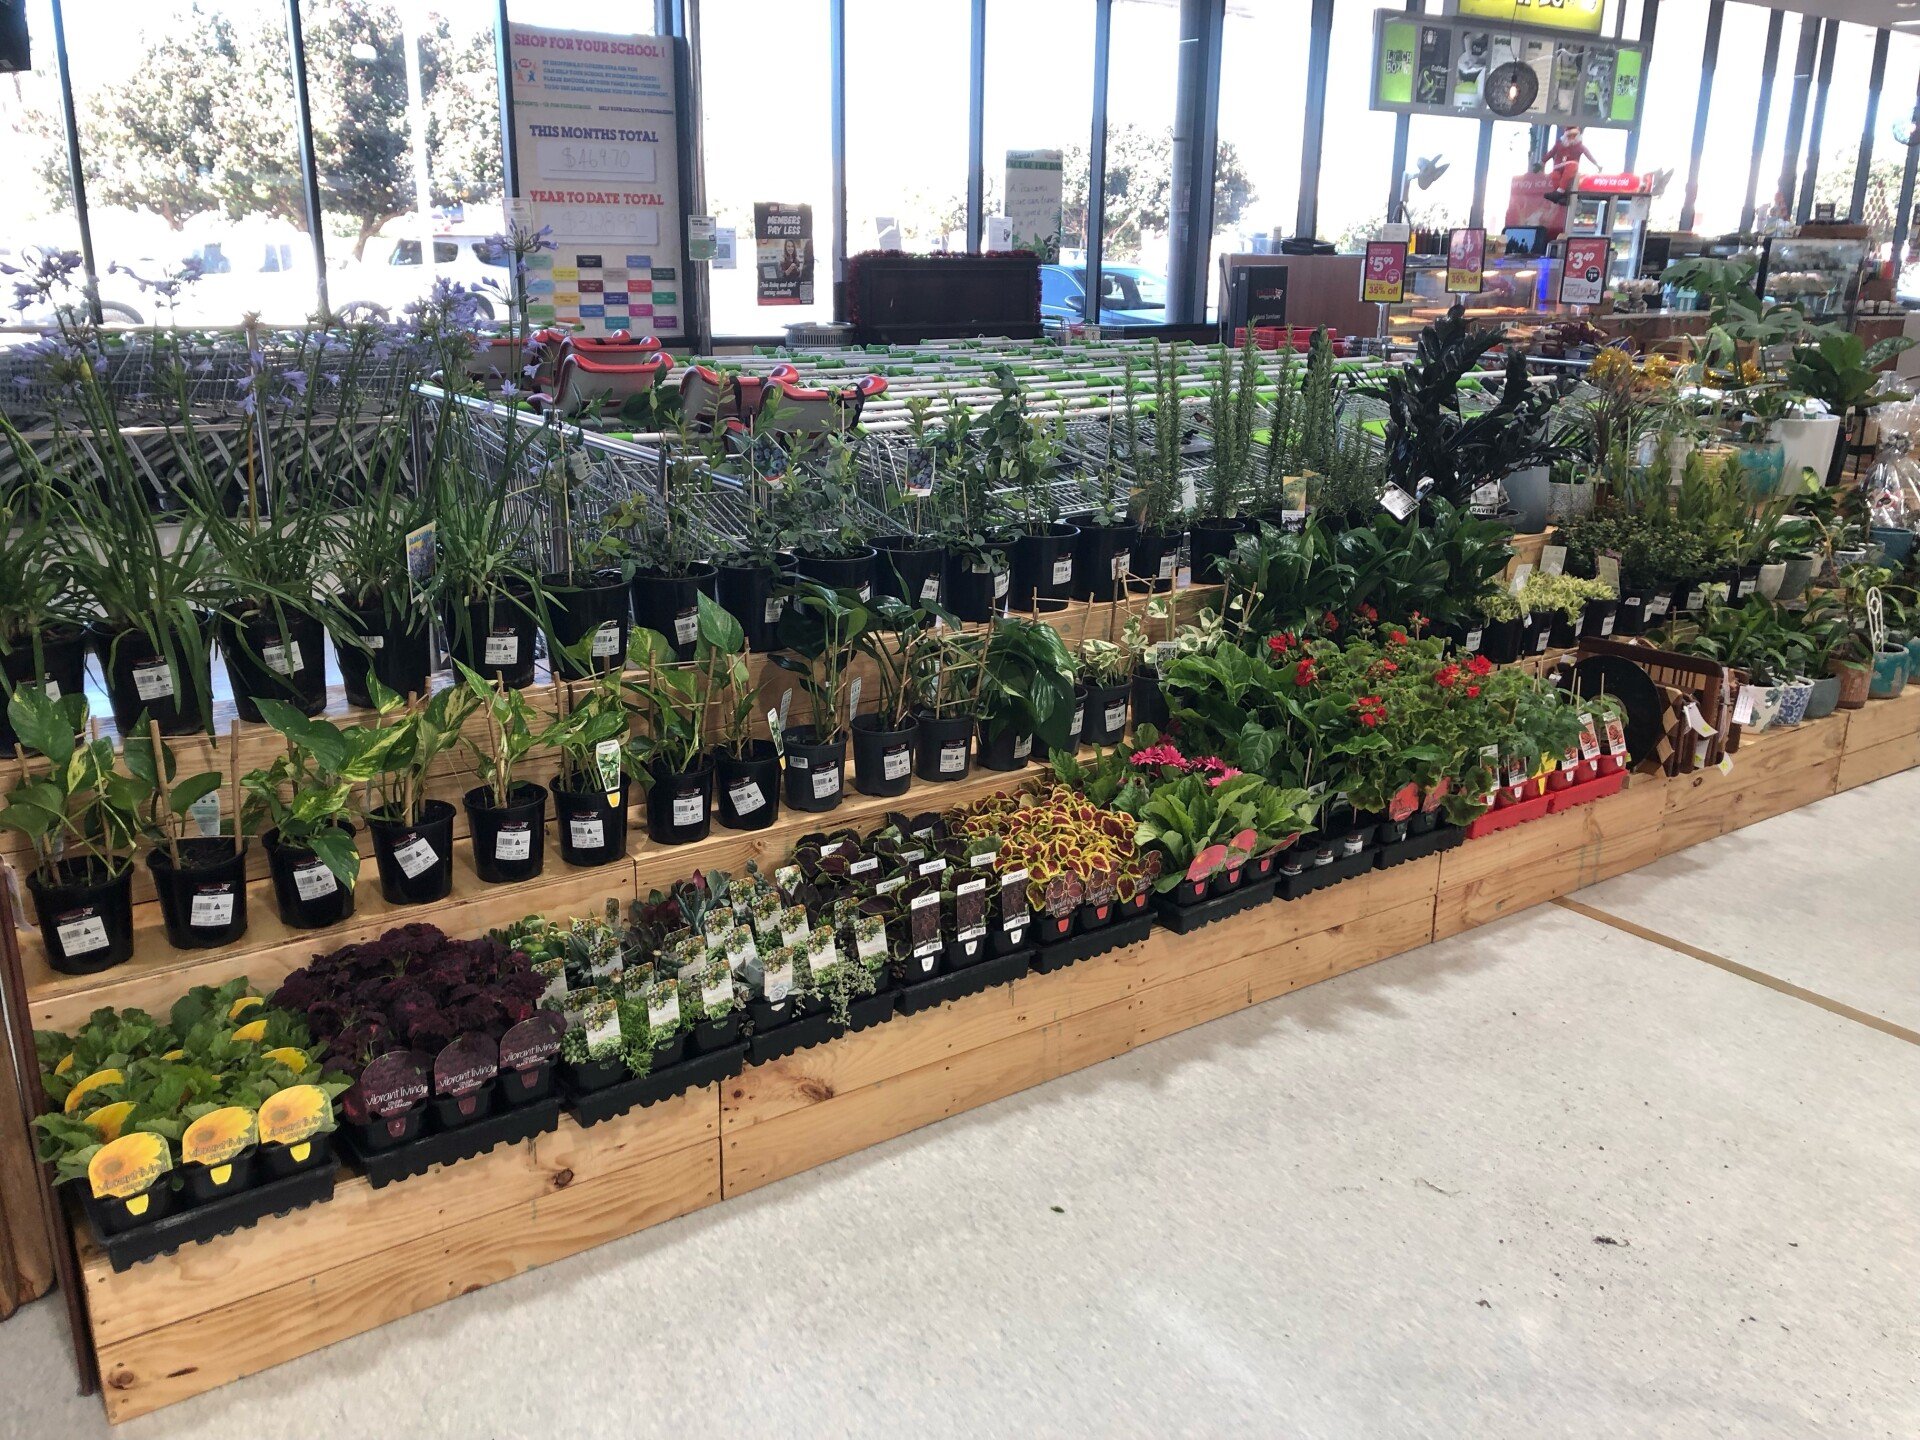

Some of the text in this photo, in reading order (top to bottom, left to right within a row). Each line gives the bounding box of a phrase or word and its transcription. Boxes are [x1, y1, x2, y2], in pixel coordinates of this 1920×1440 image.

[514, 33, 547, 48] SHOP
[550, 37, 574, 50] FOR
[574, 39, 609, 53] YOUR
[611, 42, 659, 57] SCHOOL
[529, 125, 659, 142] THIS MONTHS TOTAL
[530, 190, 664, 206] YEAR TO DATE TOTAL
[766, 215, 801, 225] MEMBERS
[767, 225, 801, 235] PAY LESS
[1368, 285, 1398, 295] 35% off
[976, 855, 991, 863] Coleus
[856, 861, 872, 869] Coleus
[925, 863, 941, 871] Coleus
[1007, 872, 1023, 881] Coleus
[964, 882, 980, 891] Coleus
[917, 896, 934, 905] Coleus
[504, 1042, 557, 1063] vibrant living
[439, 1065, 494, 1088] vibrant living
[366, 1083, 424, 1106] vibrant living
